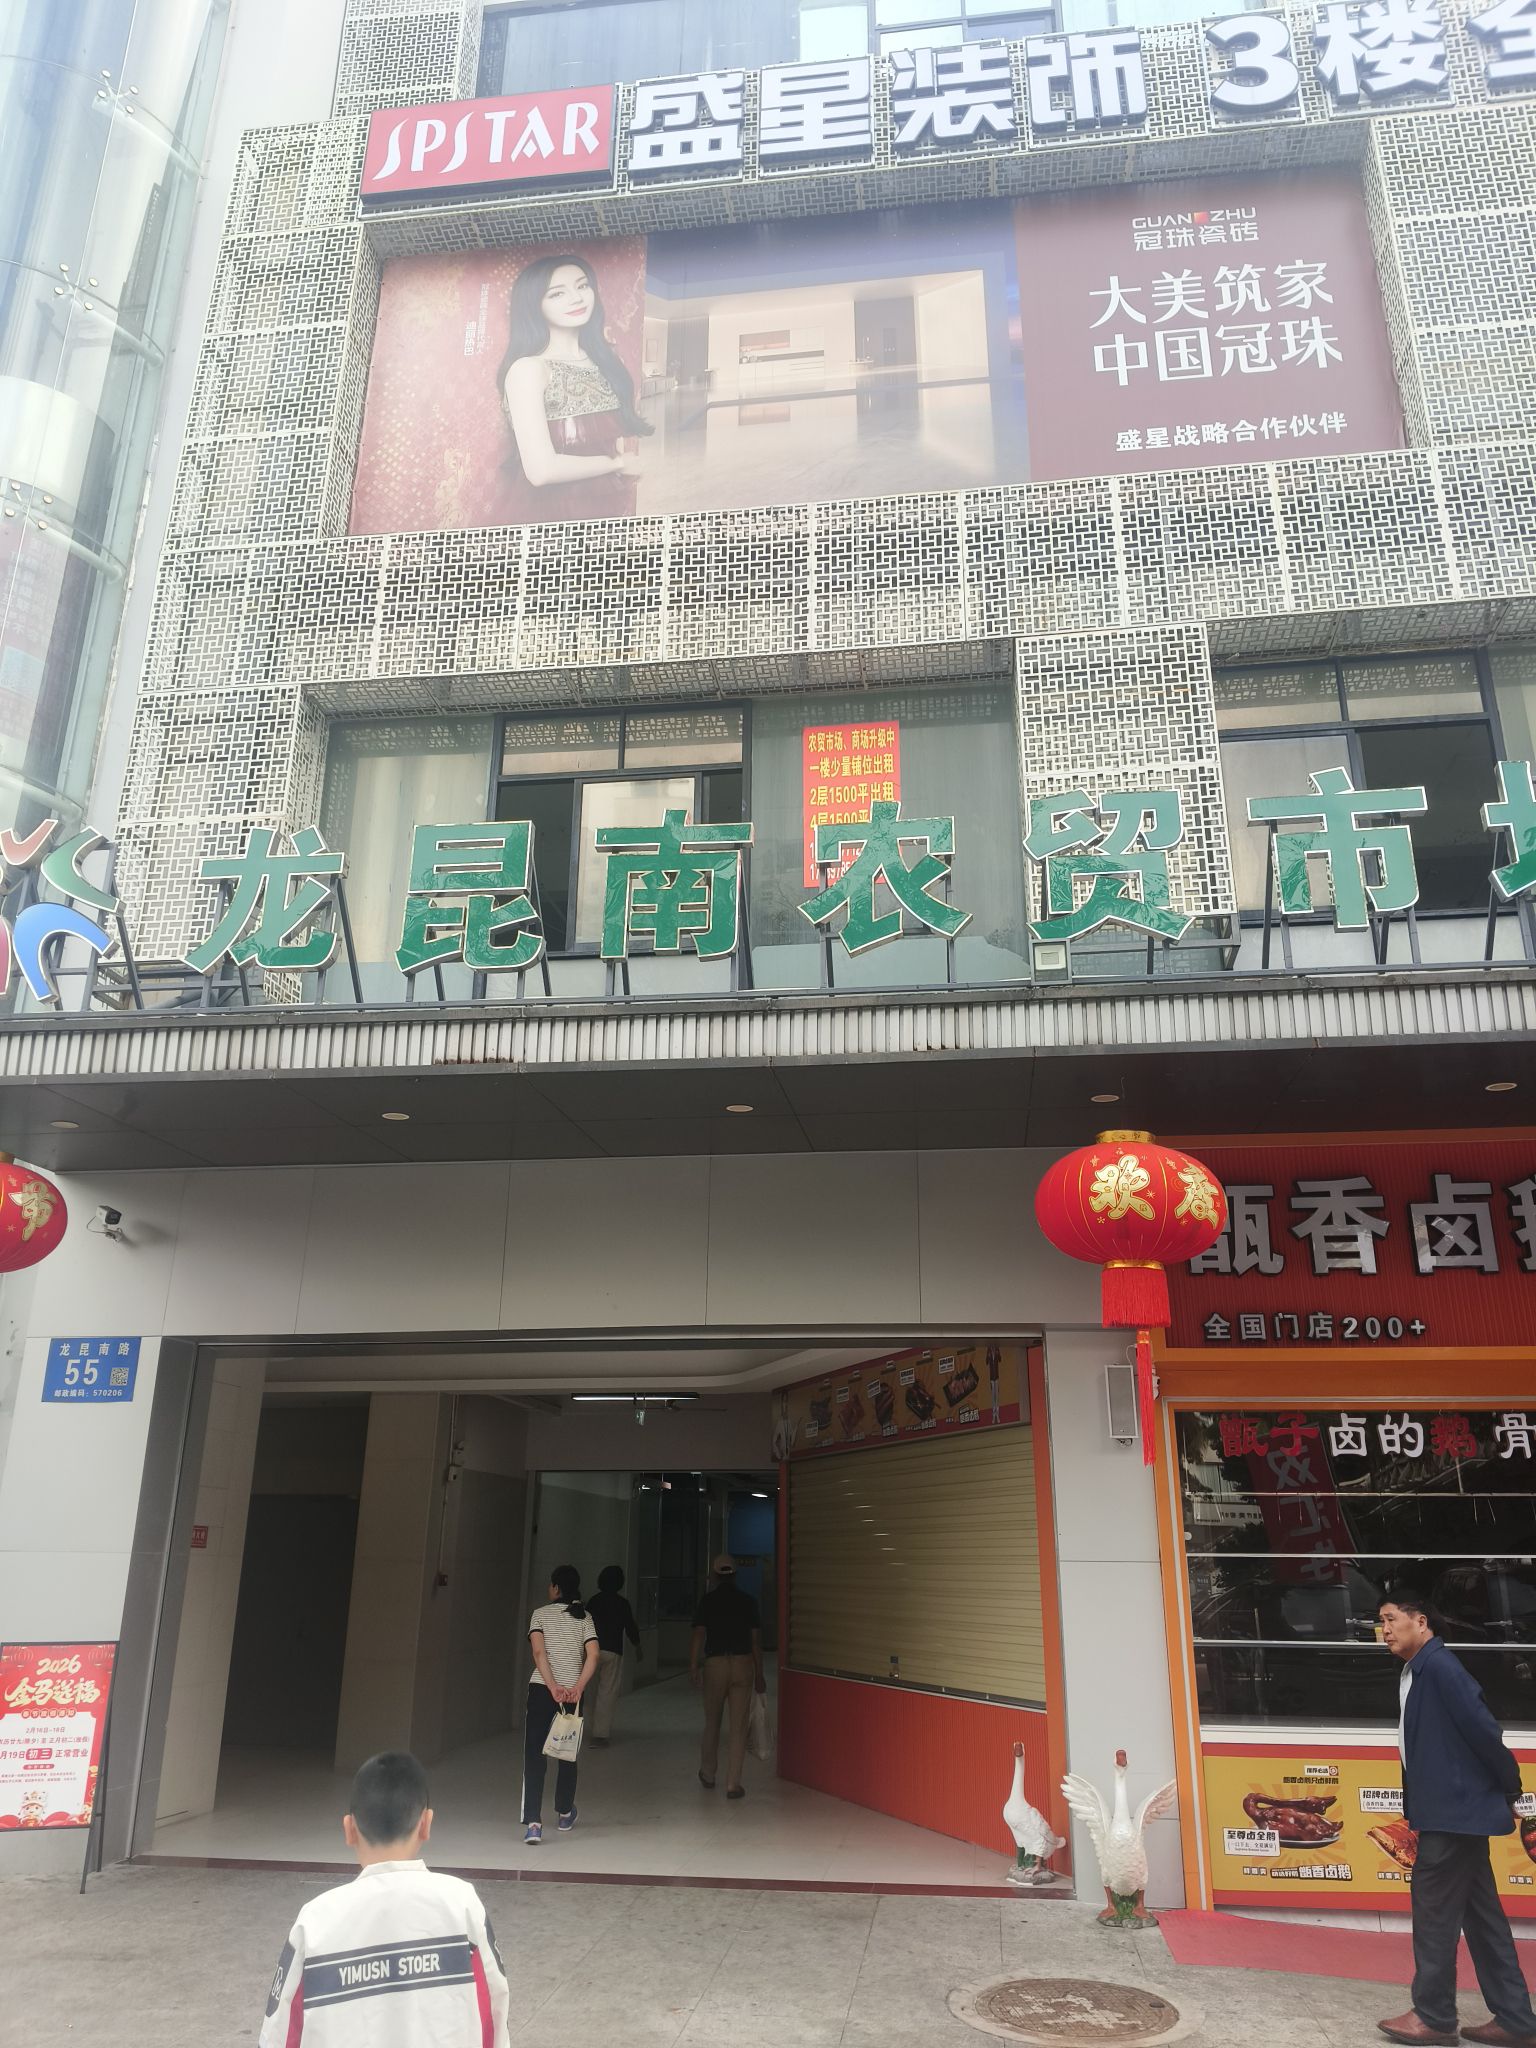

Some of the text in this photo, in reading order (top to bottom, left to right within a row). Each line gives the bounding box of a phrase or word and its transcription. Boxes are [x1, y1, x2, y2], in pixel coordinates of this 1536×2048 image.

[628, 31, 1147, 173] 盛星装饰
[372, 101, 601, 181] SPSTAR
[1133, 222, 1260, 252] 冠珠瓷砖
[1089, 259, 1335, 329] 大美筑家
[1092, 315, 1343, 388] 中国冠珠
[1115, 412, 1349, 452] 盛星战略合作伙伴
[808, 728, 895, 753] 农贸市场、商场升级中
[809, 753, 894, 778] 一楼少量铺位出租
[810, 781, 894, 806] 2层1500平出租
[1203, 1312, 1427, 1341] 全国门店200+
[59, 1342, 130, 1357] 龙昆南路
[64, 1358, 100, 1386] 55
[36, 1654, 82, 1676] 2026
[5, 1676, 101, 1708] 金马送福
[1227, 1830, 1276, 1841] 至尊卤全鹅
[338, 1953, 441, 1986] YIMUSN STOER
